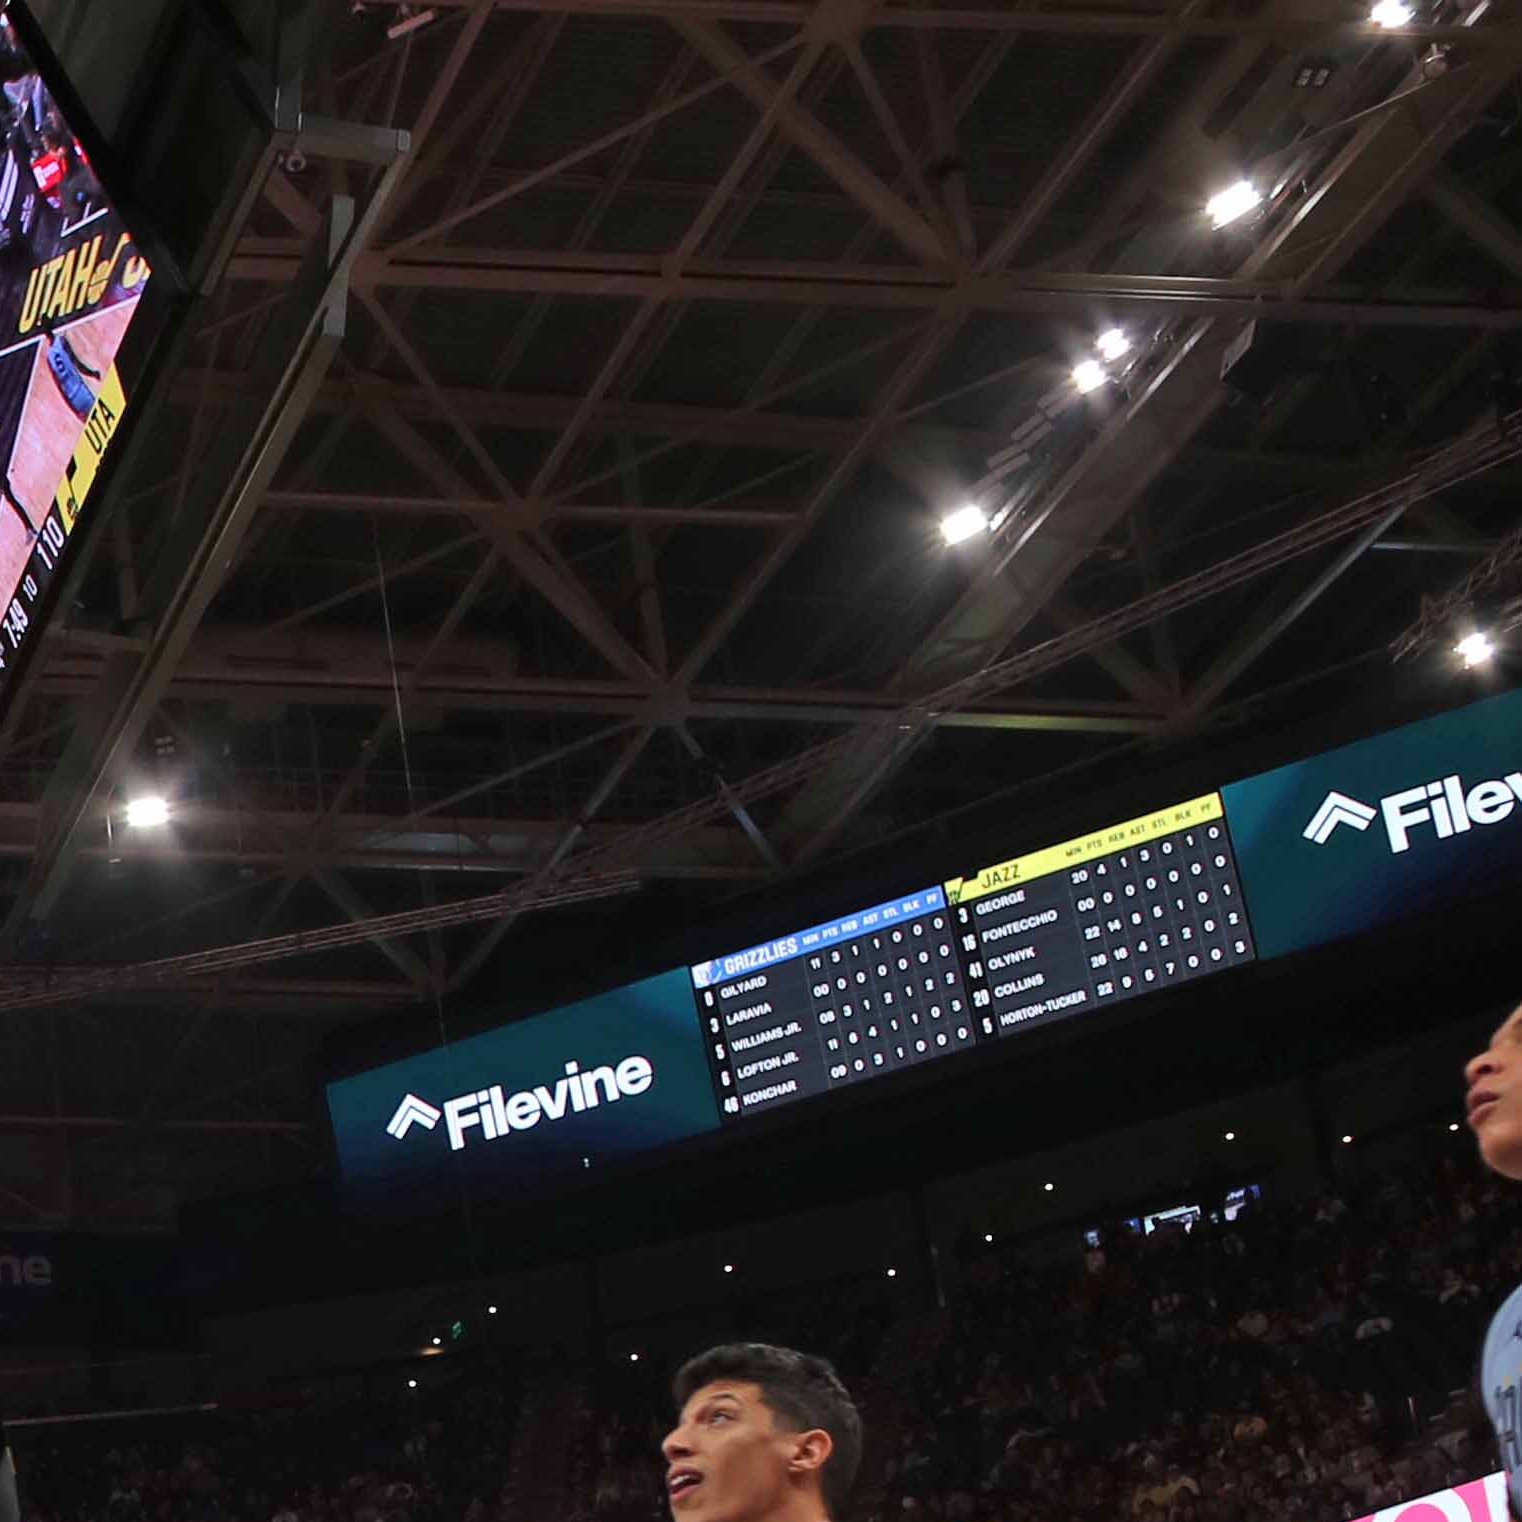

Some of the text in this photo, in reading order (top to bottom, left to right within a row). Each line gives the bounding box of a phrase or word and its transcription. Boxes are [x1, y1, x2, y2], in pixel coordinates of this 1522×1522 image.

[1, 599, 29, 649] 7:49
[21, 574, 38, 603] 10
[35, 516, 65, 571] 110
[83, 399, 115, 455] UTA
[981, 864, 1021, 889] JAZZ
[958, 890, 1026, 924] 3 GEORGE
[724, 938, 799, 975] GRIZZLIES
[987, 945, 1036, 972] OLYNYK
[719, 975, 768, 999] GILYARD
[993, 972, 1045, 1000] COLLINS
[725, 1002, 772, 1026] LARAVIA
[731, 1026, 784, 1052] WILLIAMS
[443, 1055, 654, 1151] Filevine
[742, 1080, 797, 1107] KONCHAR
